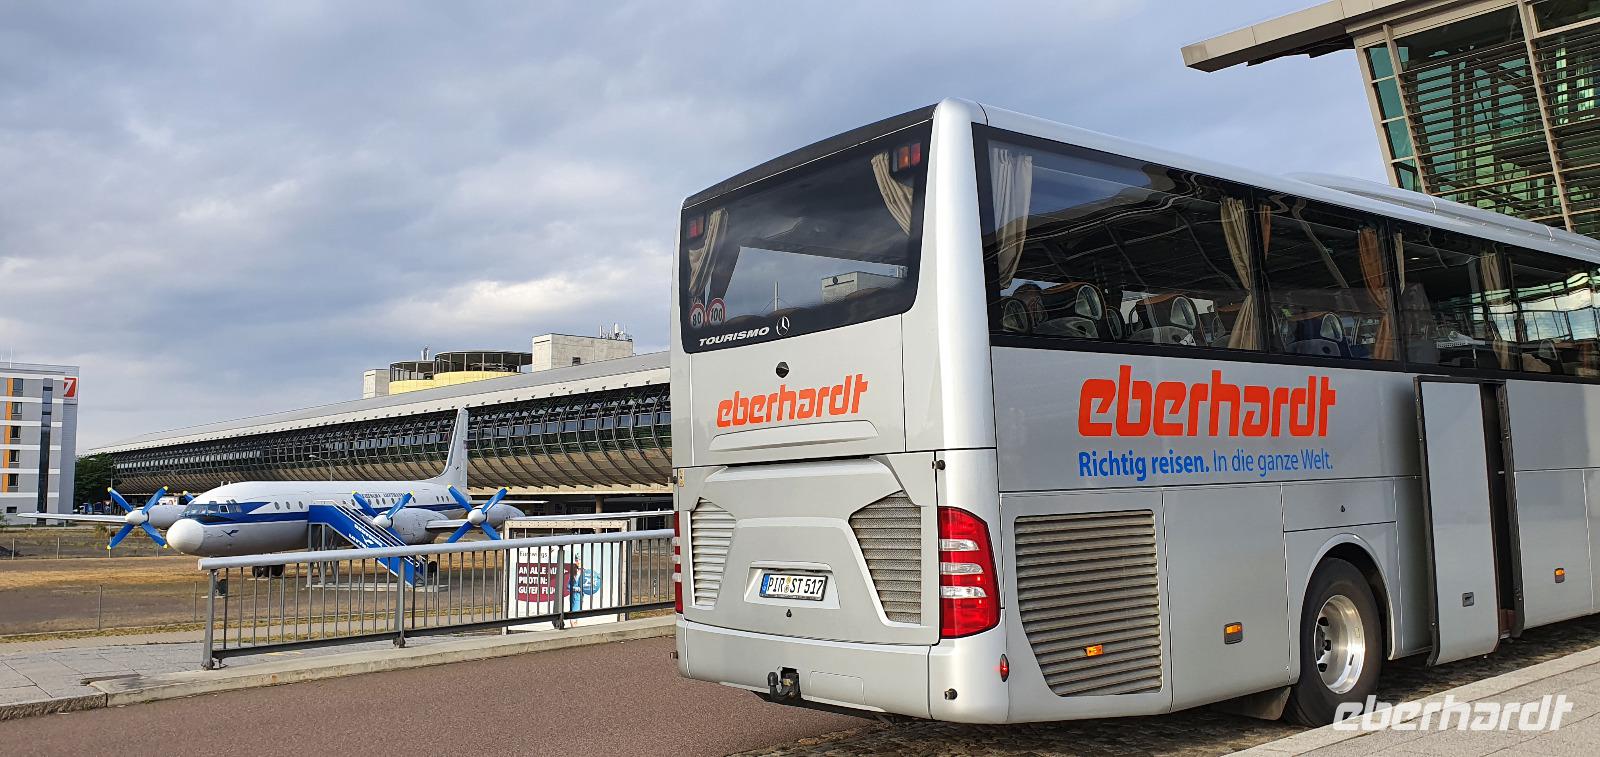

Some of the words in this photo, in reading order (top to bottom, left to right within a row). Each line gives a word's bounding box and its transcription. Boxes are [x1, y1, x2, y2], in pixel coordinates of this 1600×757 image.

[692, 311, 702, 327] 80
[710, 307, 723, 322] 100
[699, 326, 770, 347] TOURISMO
[716, 373, 869, 428] eberhardt
[1078, 364, 1336, 437] eberhardt
[1078, 450, 1147, 482] Richtig
[1151, 449, 1210, 475] reisen.
[1213, 449, 1228, 472] In
[1232, 448, 1254, 473] die
[1258, 452, 1299, 477] ganze
[1300, 447, 1334, 470] Welt.
[767, 577, 785, 592] PIR
[790, 577, 803, 594] ST
[804, 579, 824, 595] 517
